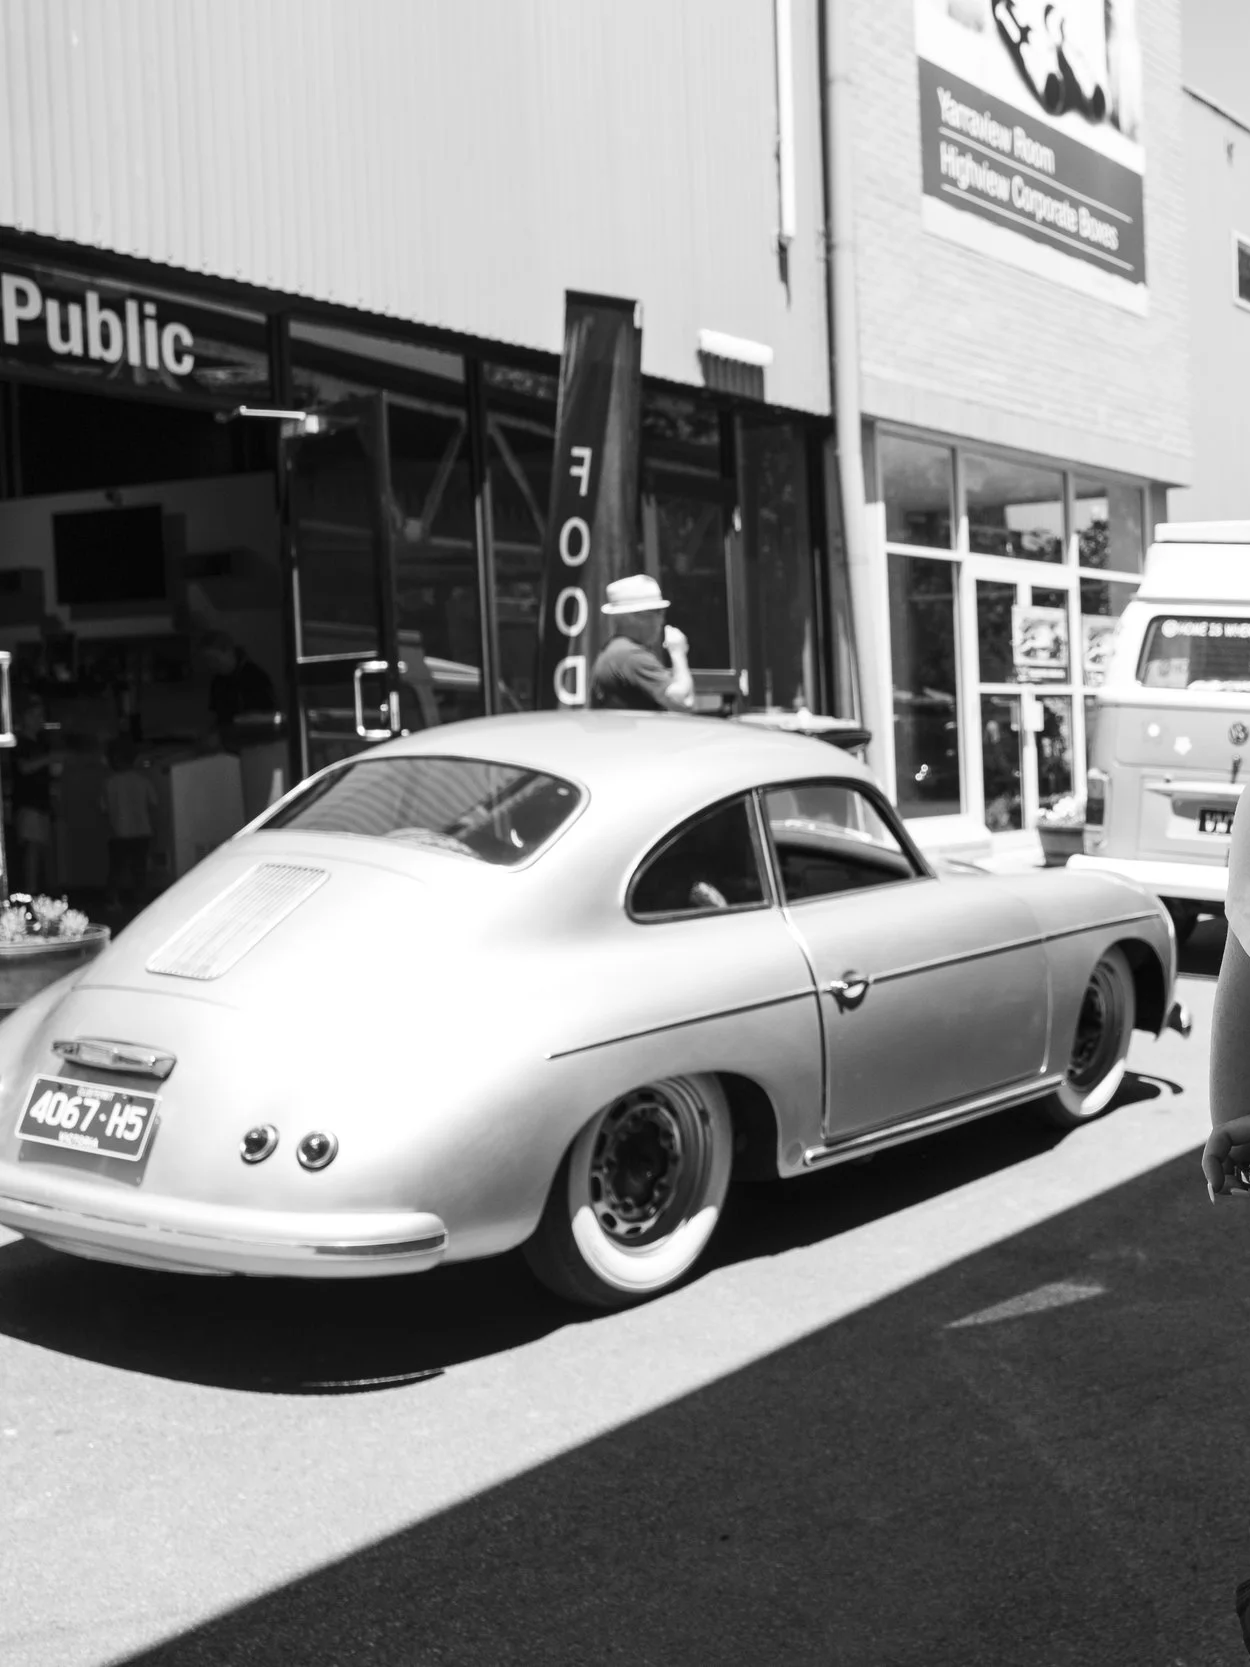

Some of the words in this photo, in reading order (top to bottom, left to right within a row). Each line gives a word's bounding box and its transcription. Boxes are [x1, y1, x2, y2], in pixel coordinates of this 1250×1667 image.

[940, 141, 1010, 201] Highview
[1011, 175, 1078, 233] Corporate
[1078, 206, 1118, 250] Boxes
[1013, 126, 1055, 175] Room
[1, 272, 195, 376] Public
